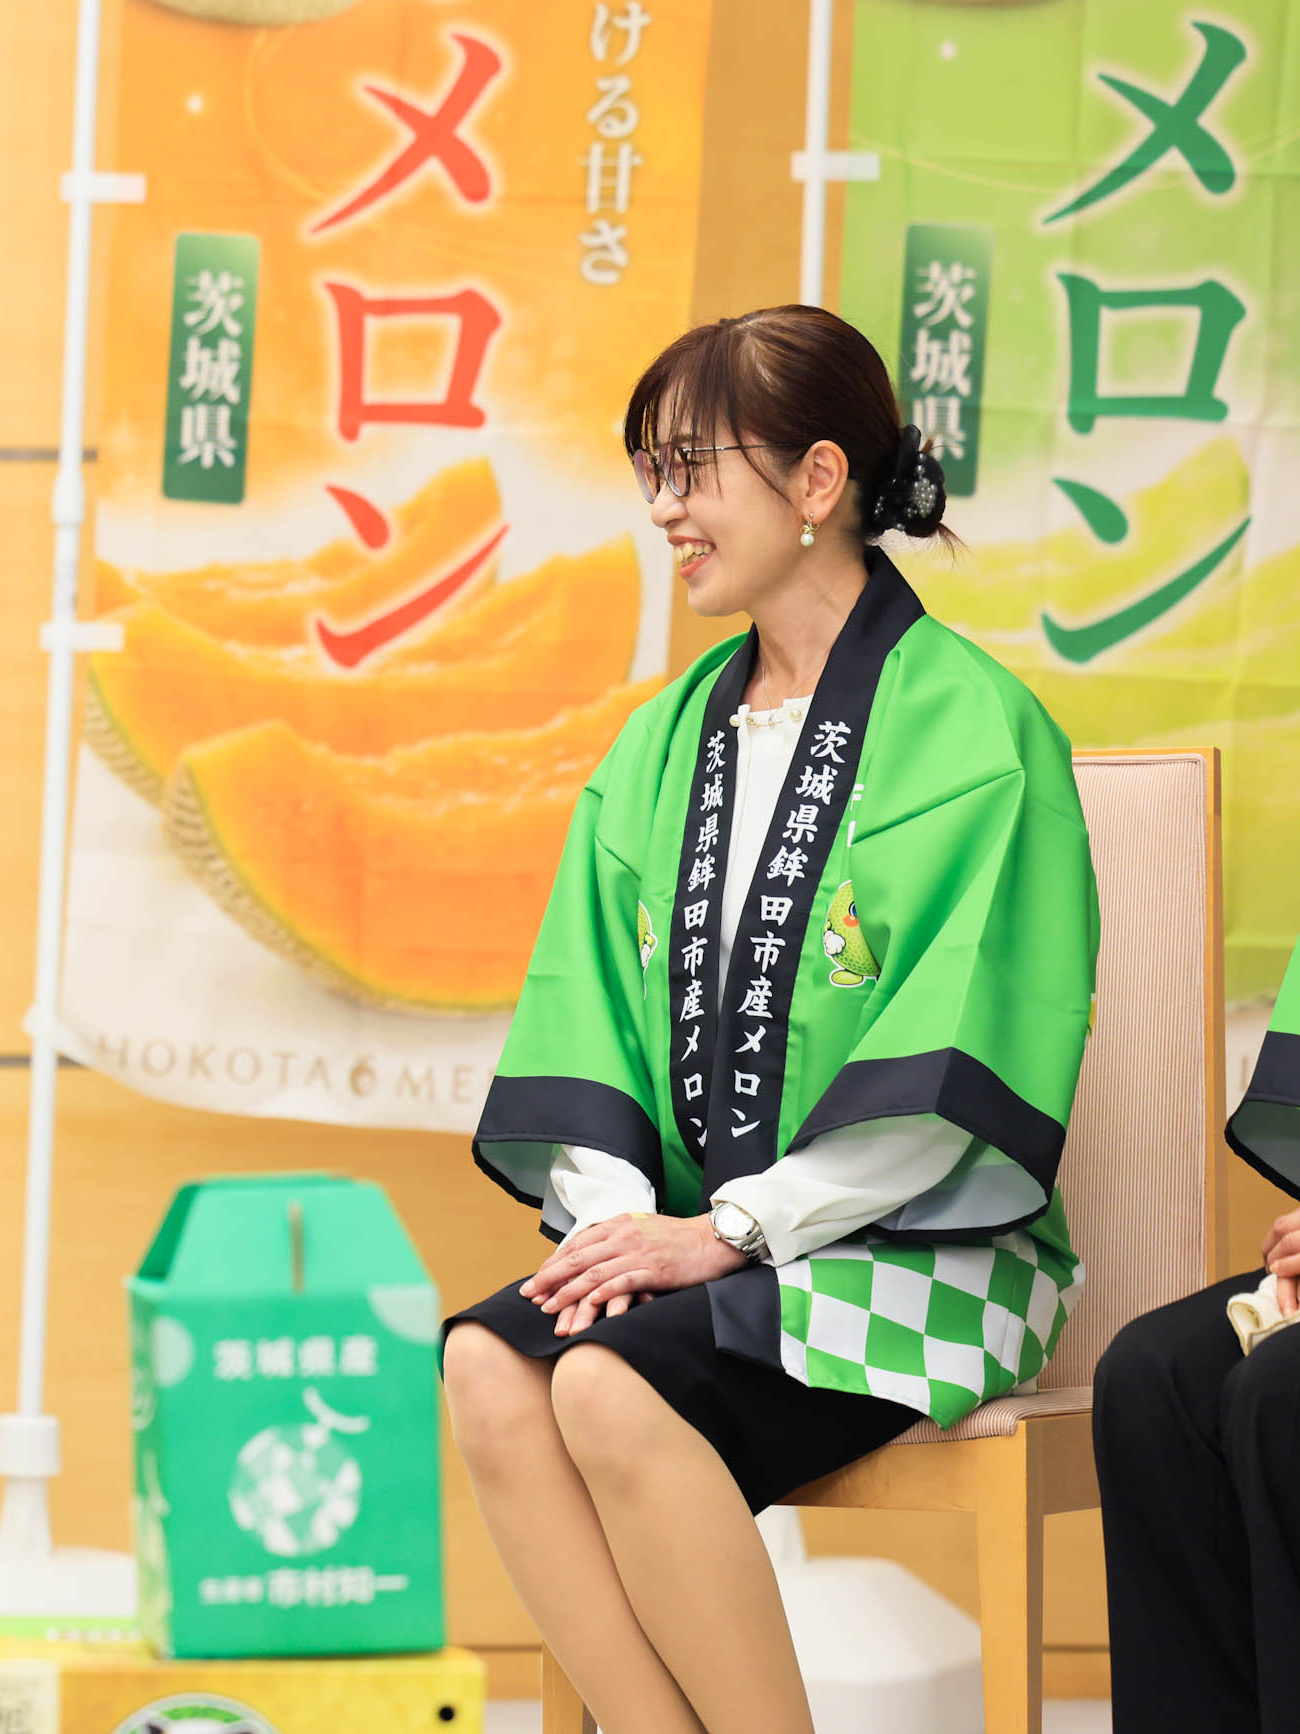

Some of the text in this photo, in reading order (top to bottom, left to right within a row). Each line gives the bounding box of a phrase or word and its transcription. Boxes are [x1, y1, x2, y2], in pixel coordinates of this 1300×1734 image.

[179, 270, 246, 470] 茨城県
[306, 30, 512, 670] メロン
[911, 261, 976, 461] 茨城県
[1040, 20, 1252, 665] メロン
[731, 720, 852, 1139] 茨城県鉾田市産メロン
